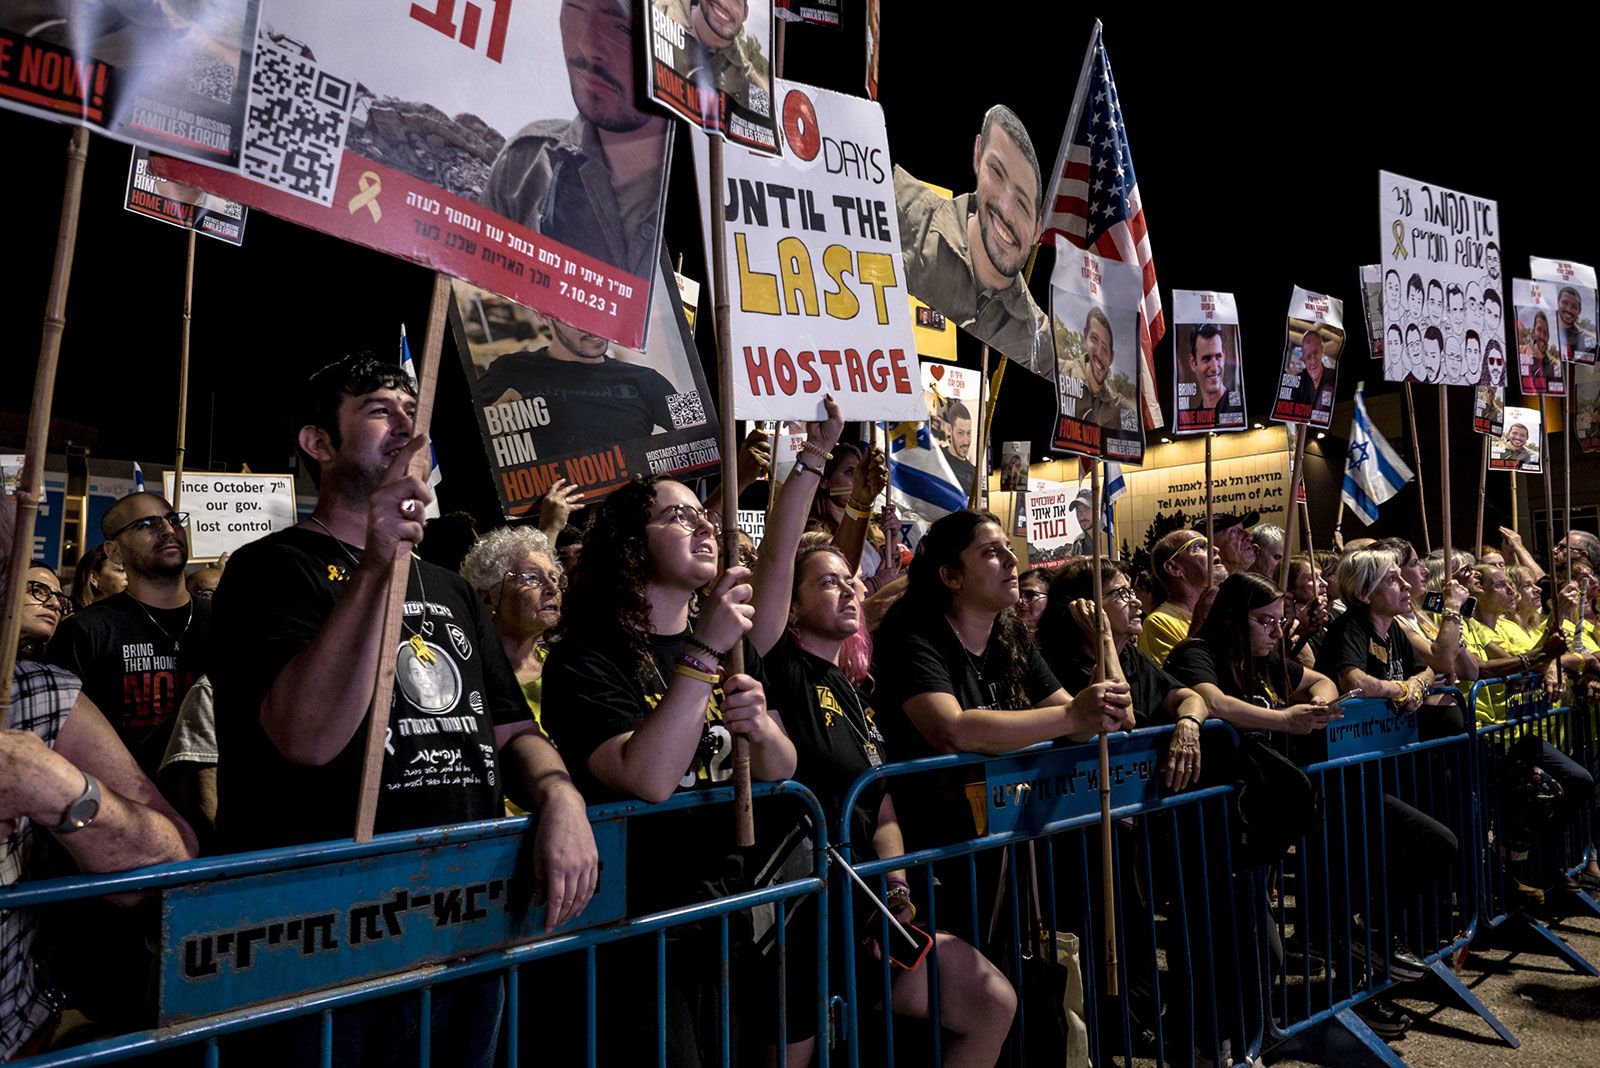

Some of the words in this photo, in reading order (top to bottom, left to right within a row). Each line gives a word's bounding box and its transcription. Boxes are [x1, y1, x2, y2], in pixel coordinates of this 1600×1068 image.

[652, 5, 685, 50] BRING
[654, 31, 674, 69] HIM
[19, 44, 107, 105] NOW!
[656, 61, 685, 104] HOME
[133, 108, 185, 137] FAMILIES
[189, 125, 231, 151] FORUM
[823, 137, 885, 184] DAYS
[134, 174, 155, 192] HIM
[131, 189, 161, 210] HOME
[163, 198, 194, 220] NOW!
[407, 190, 440, 216] לעזה
[725, 178, 827, 232] UNTIL
[832, 194, 892, 243] THE
[1392, 186, 1413, 217] עד
[1421, 185, 1470, 237] תקומה
[445, 206, 482, 234] ונחטף
[1474, 200, 1494, 241] אין
[445, 232, 477, 255] שלנו
[486, 224, 505, 243] עוז
[507, 232, 535, 257] בנחל
[1412, 227, 1448, 263] חוזרים
[539, 247, 561, 269] לחם
[564, 260, 577, 276] חן
[581, 267, 604, 287] איתי
[734, 232, 898, 325] LAST
[560, 281, 606, 311] 7.10.23
[609, 302, 618, 316] ב
[743, 346, 913, 397] HOSTAGE
[1060, 374, 1083, 399] BRING
[483, 396, 551, 436] BRING
[1061, 394, 1076, 418] HIM
[1059, 418, 1082, 442] HOME
[492, 431, 538, 468] HIM
[646, 446, 678, 461] HOSTAGES
[677, 443, 690, 454] AND
[690, 437, 717, 452] MISSING
[649, 454, 689, 475] FAMILIES
[689, 447, 720, 466] FORUM
[501, 462, 563, 502] HOME
[564, 444, 629, 488] NOW!
[1229, 475, 1243, 486] תל
[1245, 472, 1282, 485] מוזיאון
[179, 480, 209, 493] ince
[213, 480, 265, 494] October
[270, 480, 286, 494] 7th
[1056, 493, 1066, 504] לא
[1158, 498, 1172, 509] Tel
[1174, 496, 1197, 508] Aviv
[1248, 488, 1261, 500] of
[1263, 486, 1283, 498] Art
[1168, 480, 1202, 494] לאמנות
[206, 501, 229, 512] our
[235, 500, 262, 514] gov.
[1030, 494, 1056, 507] שוכחים
[1053, 504, 1066, 518] את
[196, 520, 222, 532] lost
[227, 519, 272, 532] control
[1032, 507, 1051, 520] איתי
[1033, 518, 1068, 541] בעזה
[122, 643, 154, 658] BRING
[124, 657, 151, 673] THEM
[153, 656, 177, 671] HOME
